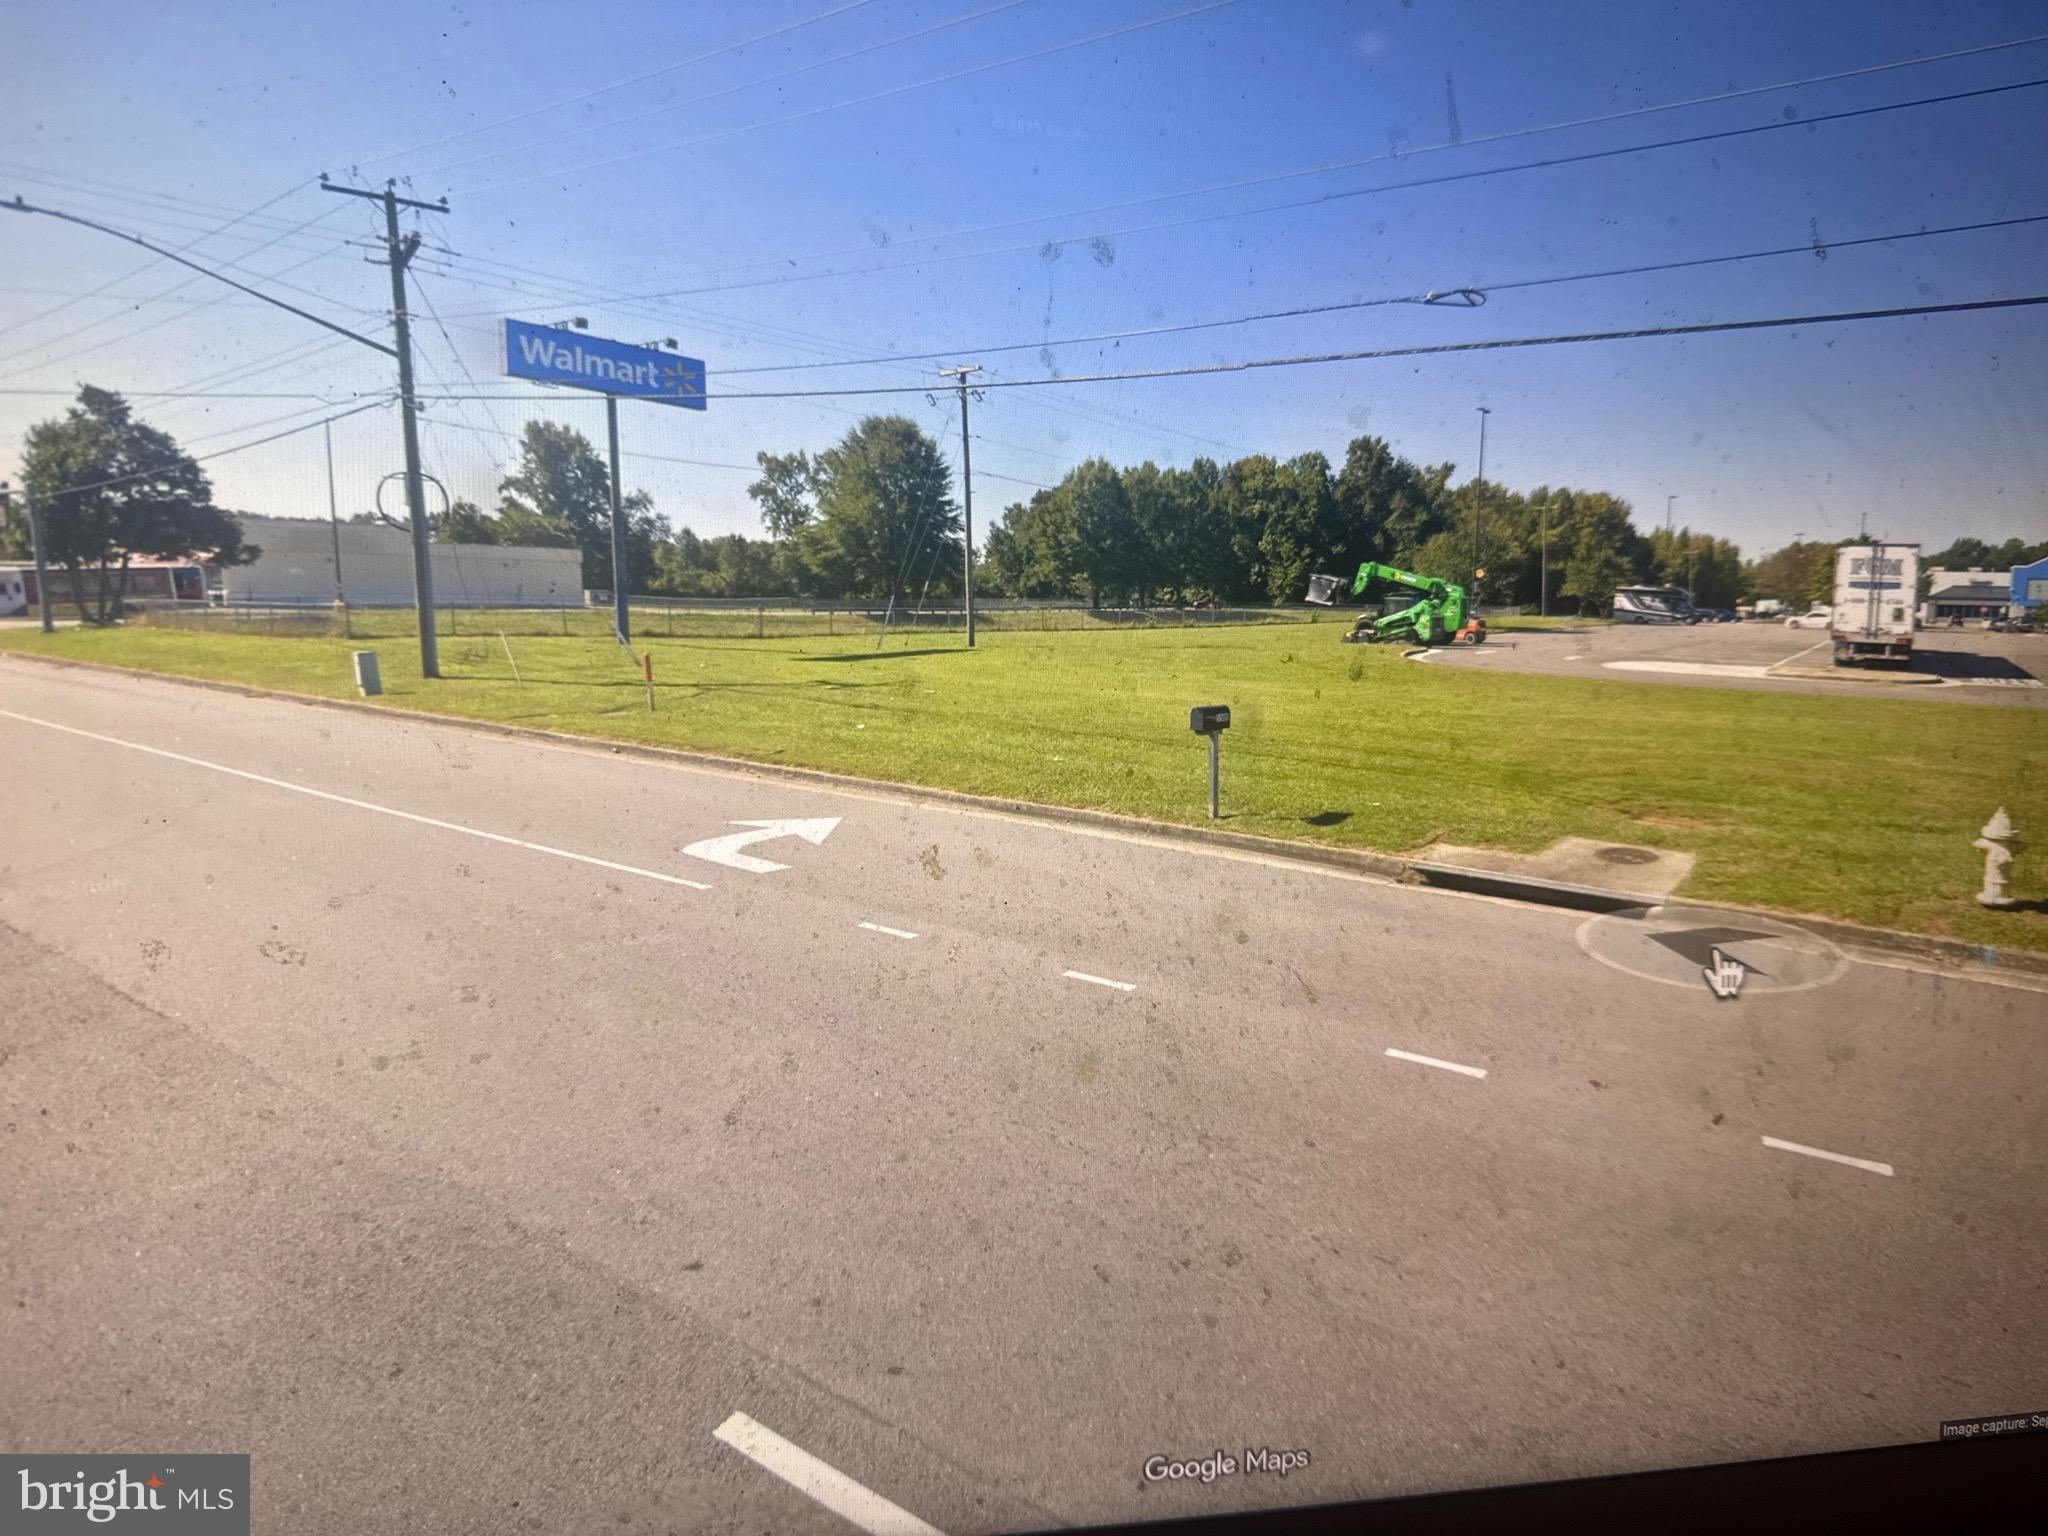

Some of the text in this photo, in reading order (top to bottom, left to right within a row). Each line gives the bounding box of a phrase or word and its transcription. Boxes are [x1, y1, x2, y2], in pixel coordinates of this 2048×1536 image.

[519, 335, 660, 389] Walmart
[1943, 1424, 1979, 1437] Image
[1982, 1418, 2029, 1434] capture:
[1145, 1449, 1309, 1483] Google Maps
